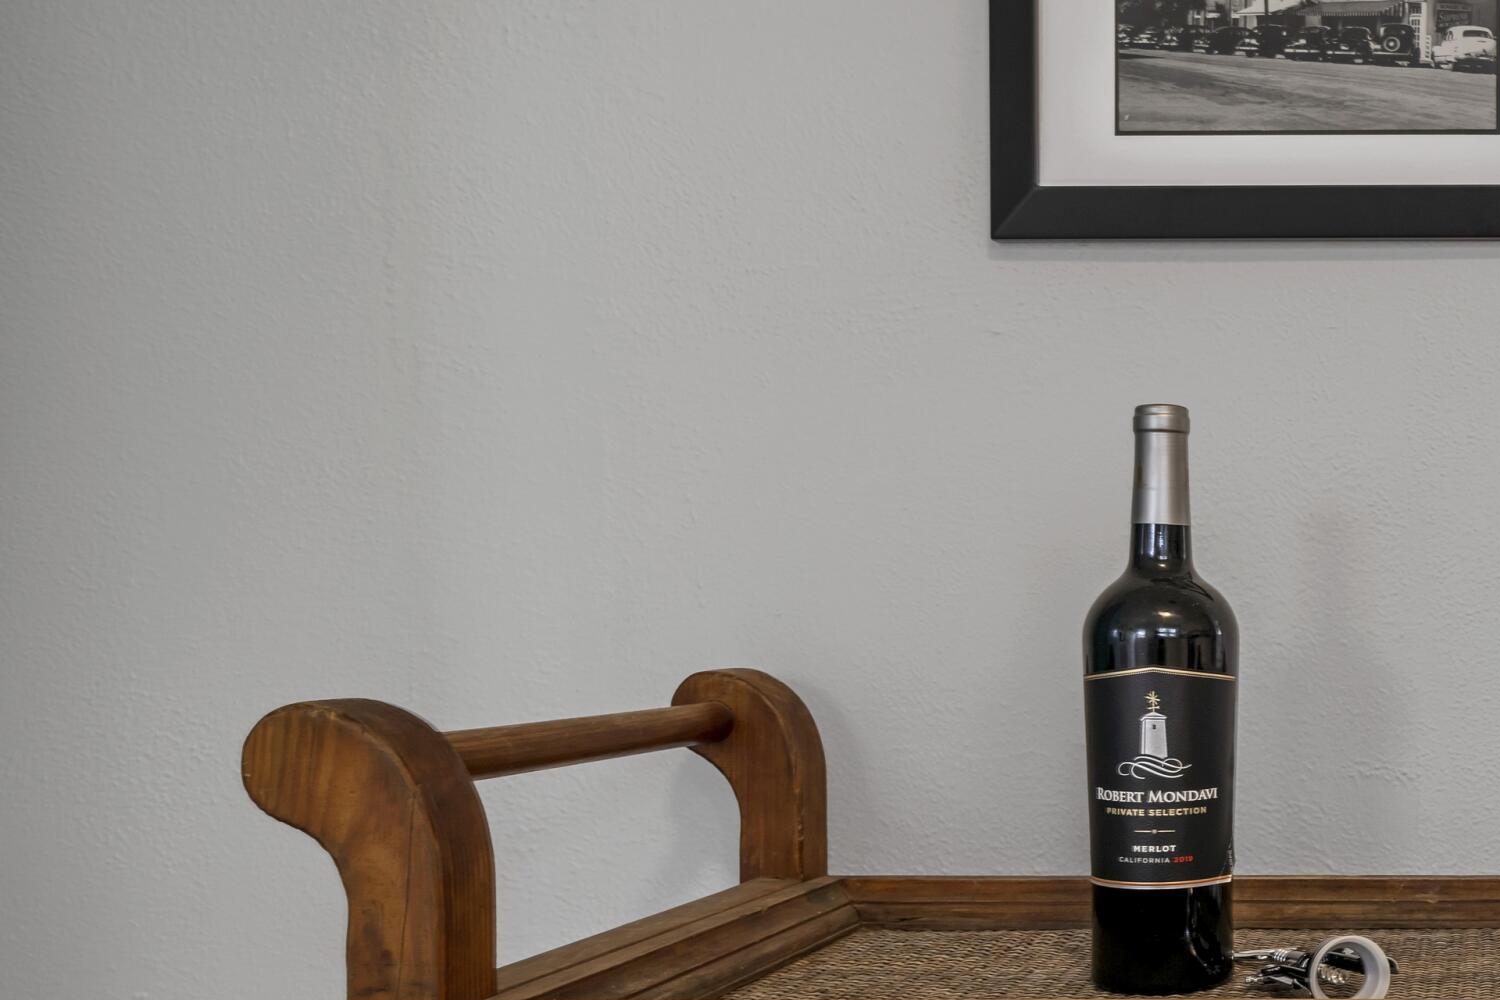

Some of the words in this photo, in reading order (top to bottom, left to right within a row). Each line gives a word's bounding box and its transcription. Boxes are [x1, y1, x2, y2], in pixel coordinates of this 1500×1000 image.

[1096, 787, 1144, 803] ROBERT
[1147, 787, 1218, 803] MONDAVI
[1105, 807, 1145, 816] PRIVATE
[1148, 806, 1207, 816] SELECTION
[1132, 845, 1177, 853] MERLOT
[1119, 856, 1170, 864] CALIFORNIA
